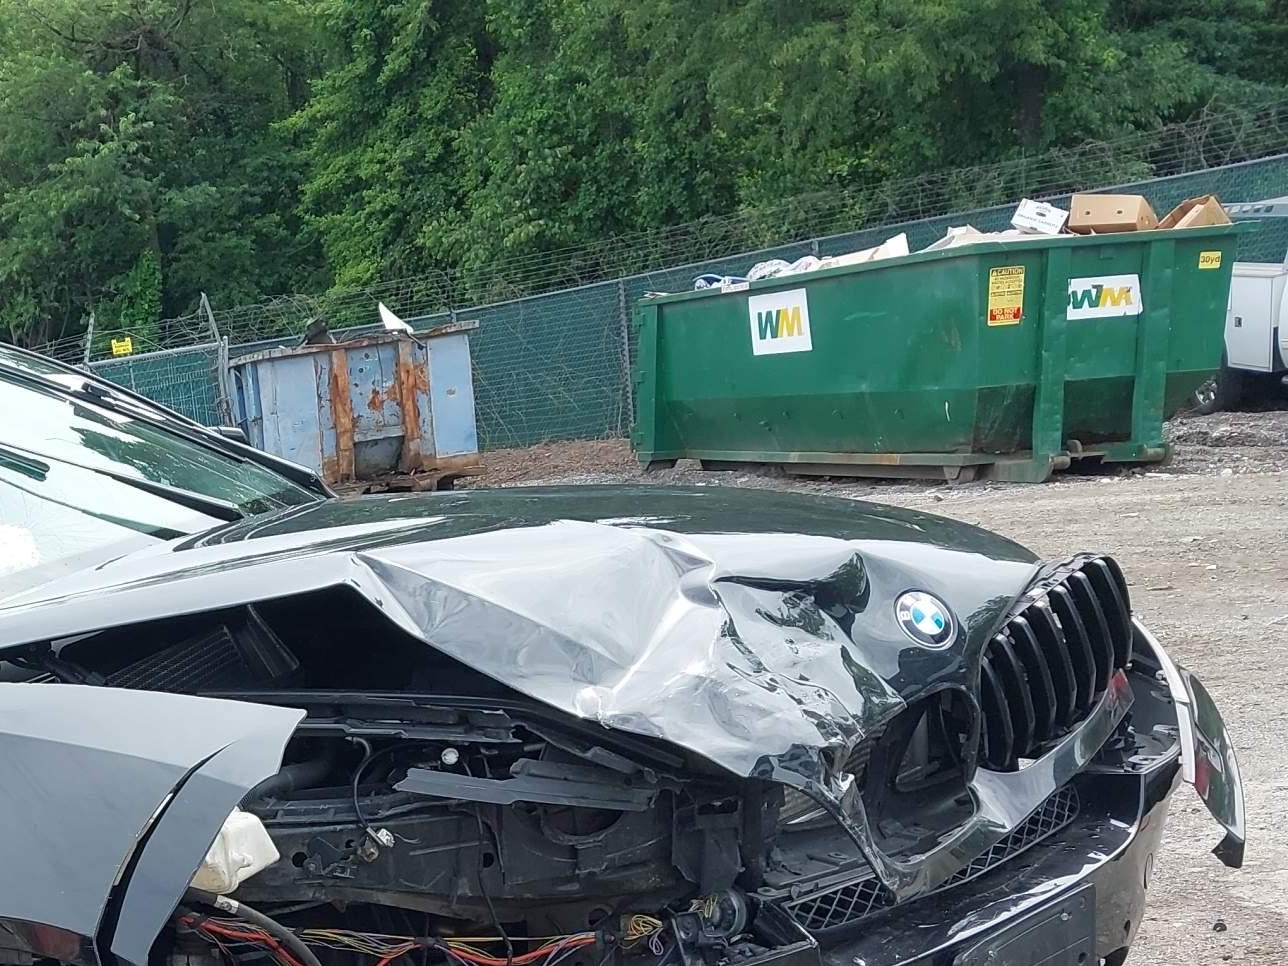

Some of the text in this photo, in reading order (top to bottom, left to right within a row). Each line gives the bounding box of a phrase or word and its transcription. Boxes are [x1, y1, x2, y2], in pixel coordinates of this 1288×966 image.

[1200, 255, 1220, 264] 30yd
[998, 268, 1023, 276] CAUTION
[1071, 285, 1132, 309] WM
[757, 306, 803, 340] WM
